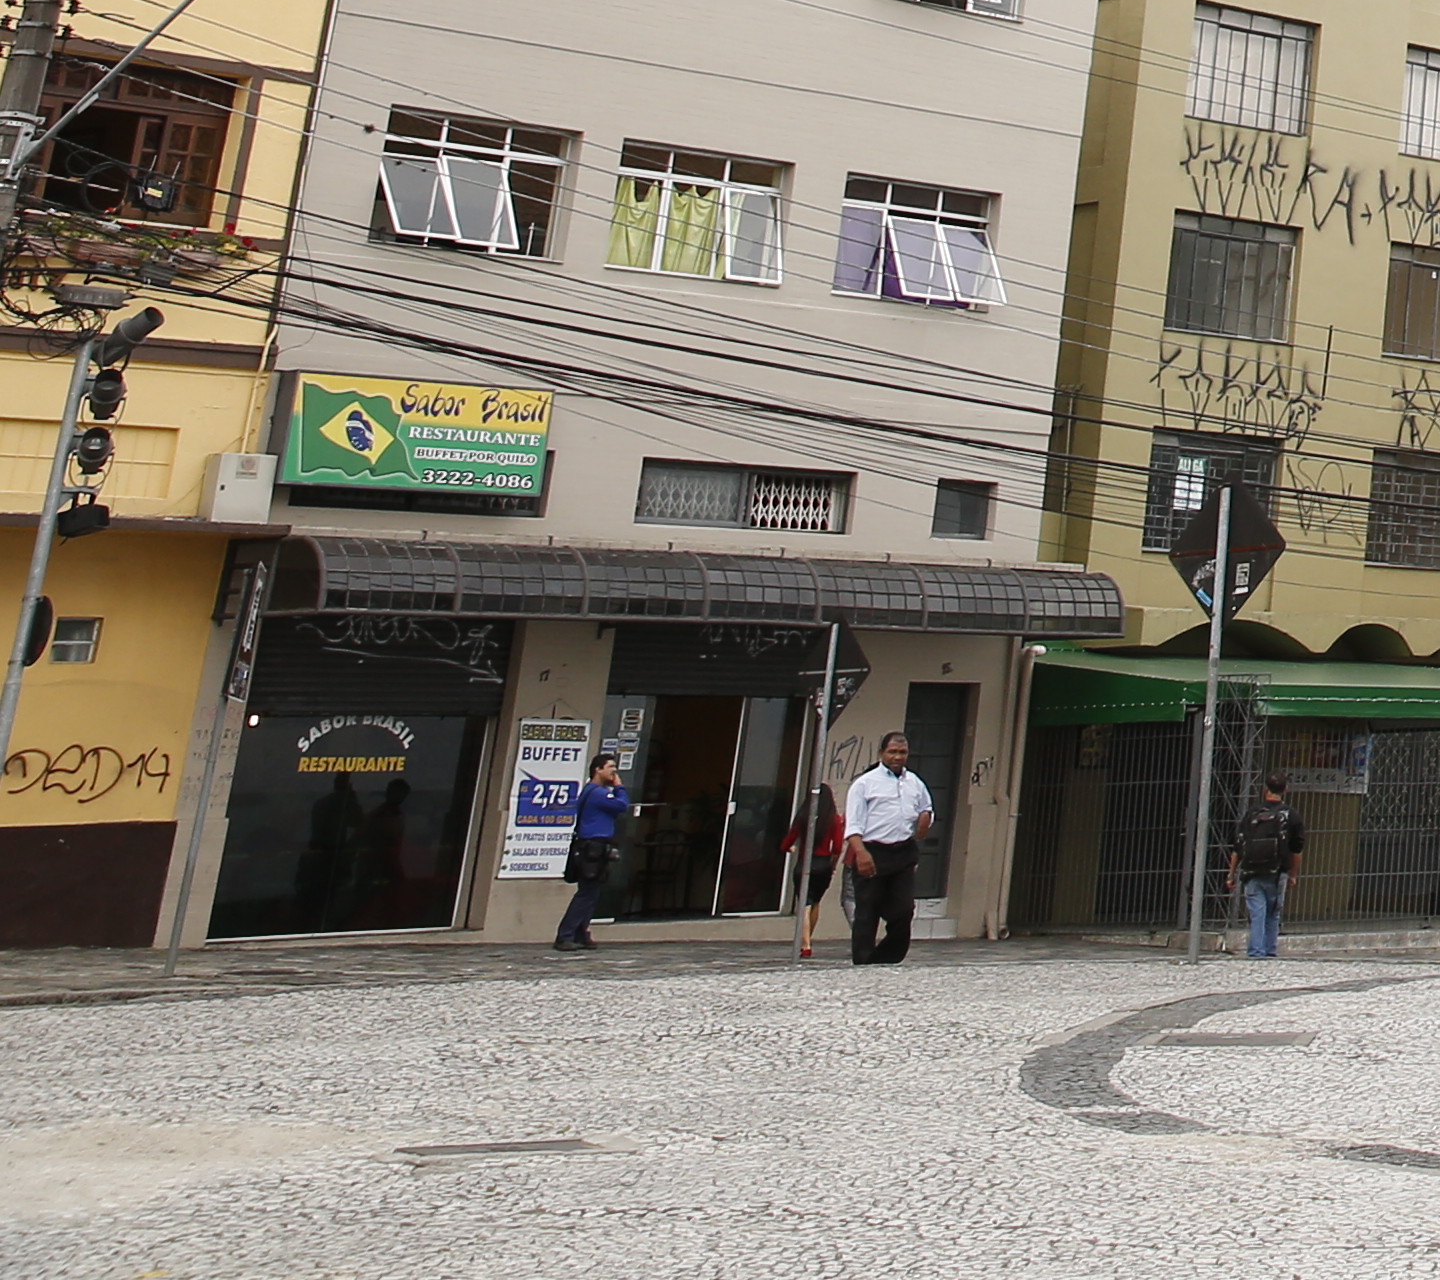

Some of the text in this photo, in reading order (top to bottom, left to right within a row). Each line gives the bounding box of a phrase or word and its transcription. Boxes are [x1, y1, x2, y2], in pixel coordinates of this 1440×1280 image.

[400, 384, 549, 424] Sabor Brasil
[408, 427, 541, 447] RESTAURANTE
[416, 448, 536, 465] BUFFET POR QUILO
[422, 470, 533, 488] 3222-4086
[297, 716, 415, 752] SABOR BRASIL
[522, 724, 588, 740] SABOR BRASIL
[522, 746, 581, 761] BUFFET
[298, 756, 406, 772] RESTAURANTE
[532, 784, 569, 808] 2,75
[547, 833, 574, 841] QUENTE
